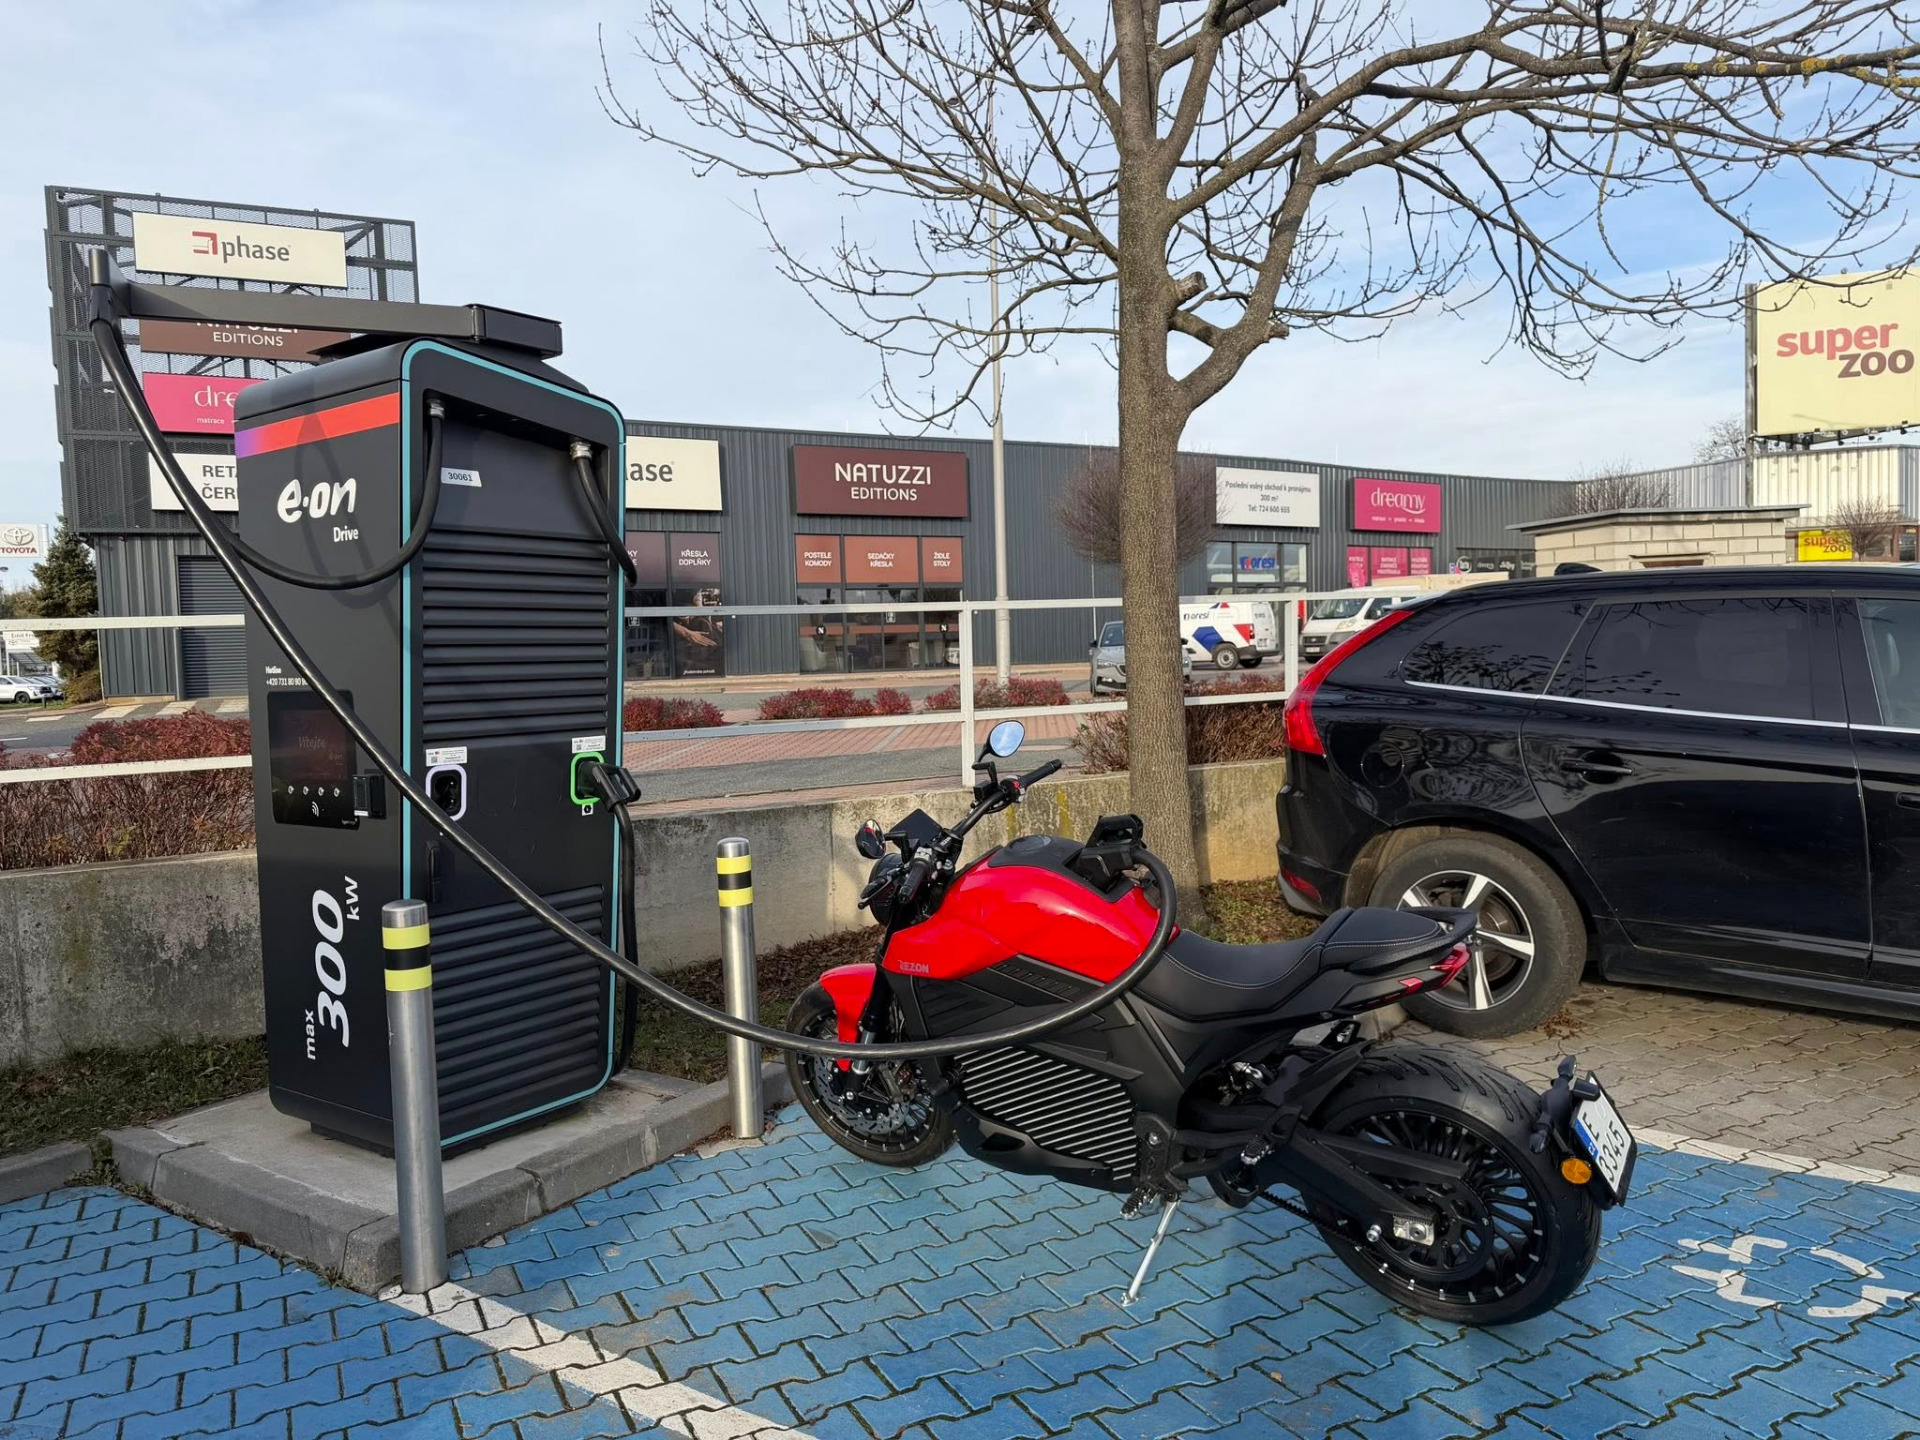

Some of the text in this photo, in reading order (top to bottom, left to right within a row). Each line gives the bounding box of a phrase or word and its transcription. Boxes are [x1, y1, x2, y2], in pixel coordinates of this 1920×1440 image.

[221, 235, 290, 264] phase
[213, 331, 284, 347] EDITIONS
[1776, 322, 1900, 361] super
[1837, 349, 1915, 379] zoo
[196, 416, 225, 425] matrace
[202, 464, 238, 478] RET
[626, 462, 673, 482] ase
[834, 462, 932, 485] NATUZZI
[850, 486, 918, 501] EDITIONS
[1371, 487, 1426, 514] dreamy
[333, 525, 359, 543] Drive
[680, 549, 708, 558] KŘESLA
[305, 875, 360, 1060] max 300 kW
[1598, 1120, 1625, 1182] 3345
